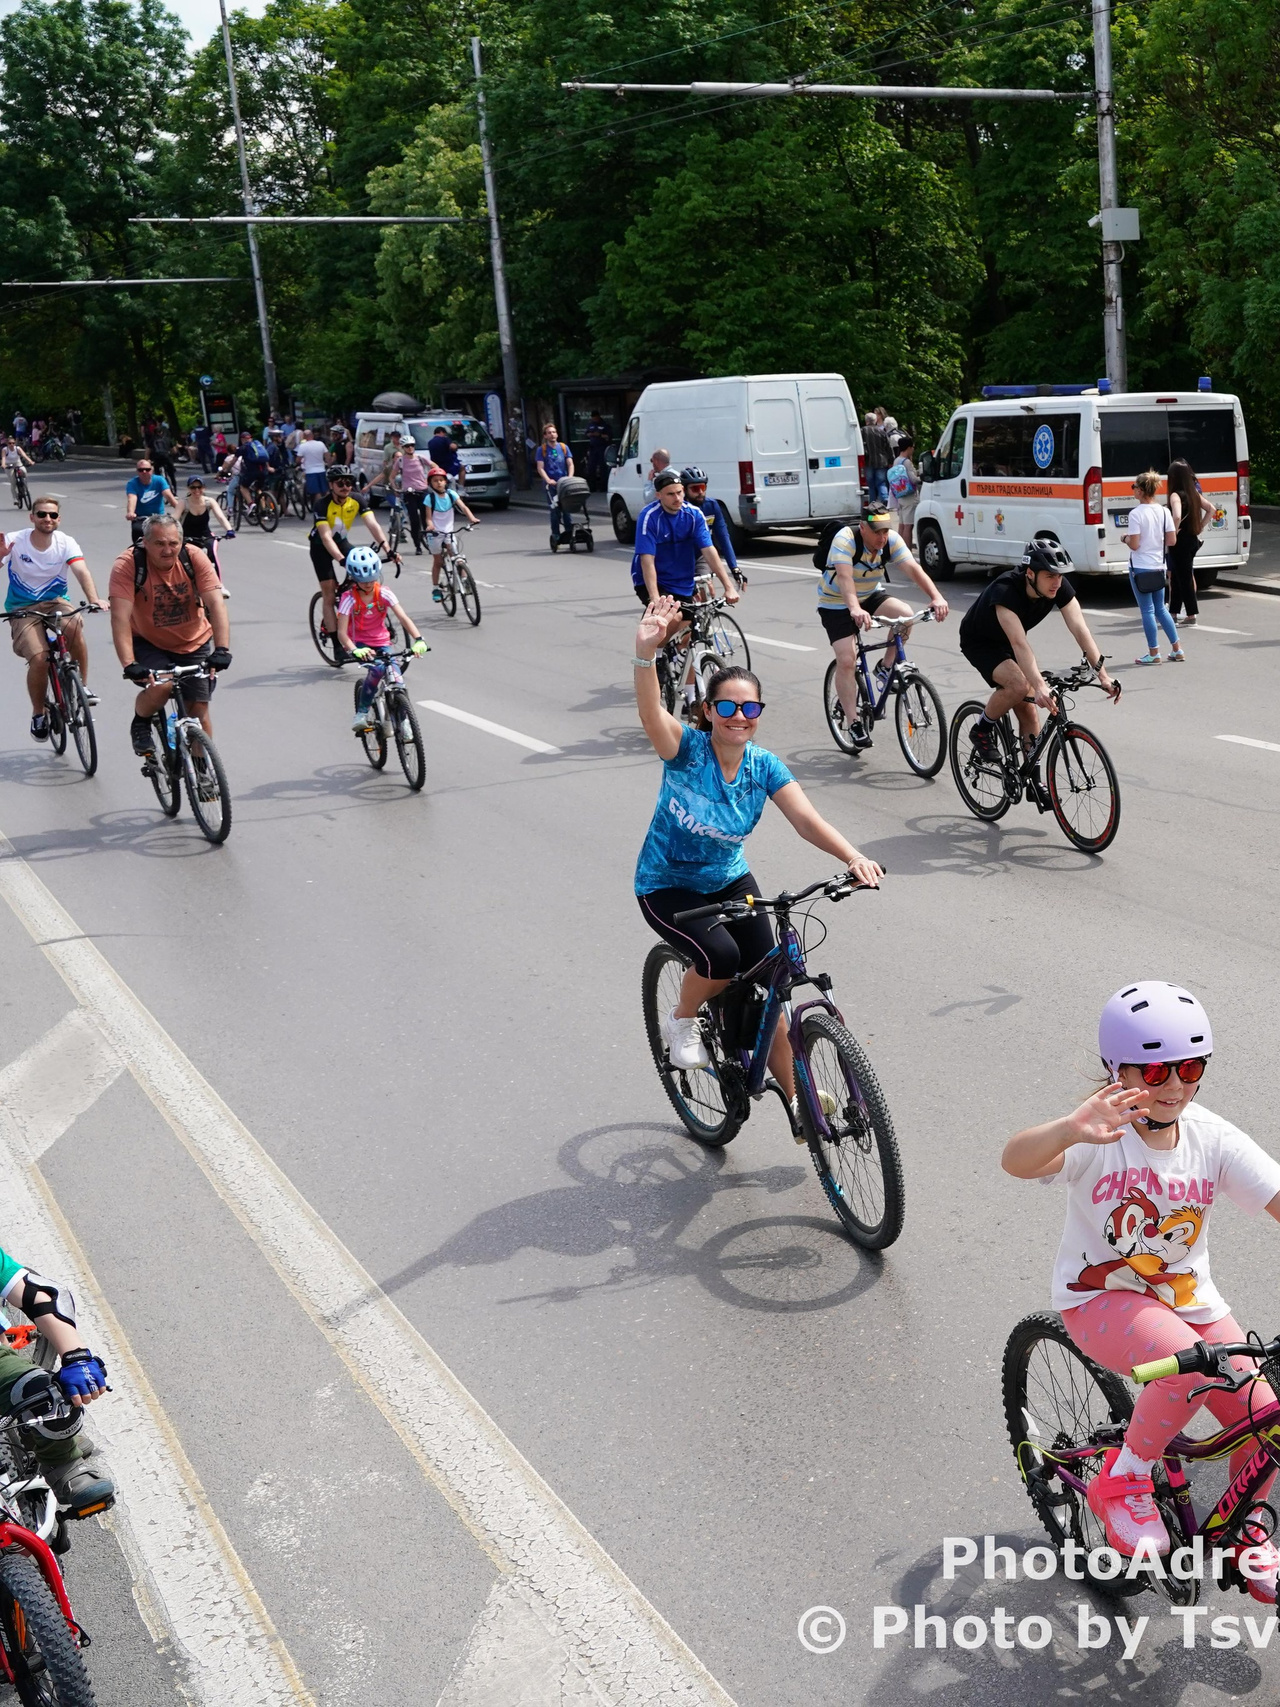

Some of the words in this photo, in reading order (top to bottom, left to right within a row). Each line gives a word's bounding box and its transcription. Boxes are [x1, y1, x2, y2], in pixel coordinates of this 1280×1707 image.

[976, 484, 996, 494] ПЪРВА
[996, 485, 1022, 496] ГРАДСКА
[1023, 486, 1053, 497] БОЛНИЦА
[1168, 1178, 1214, 1205] DALE
